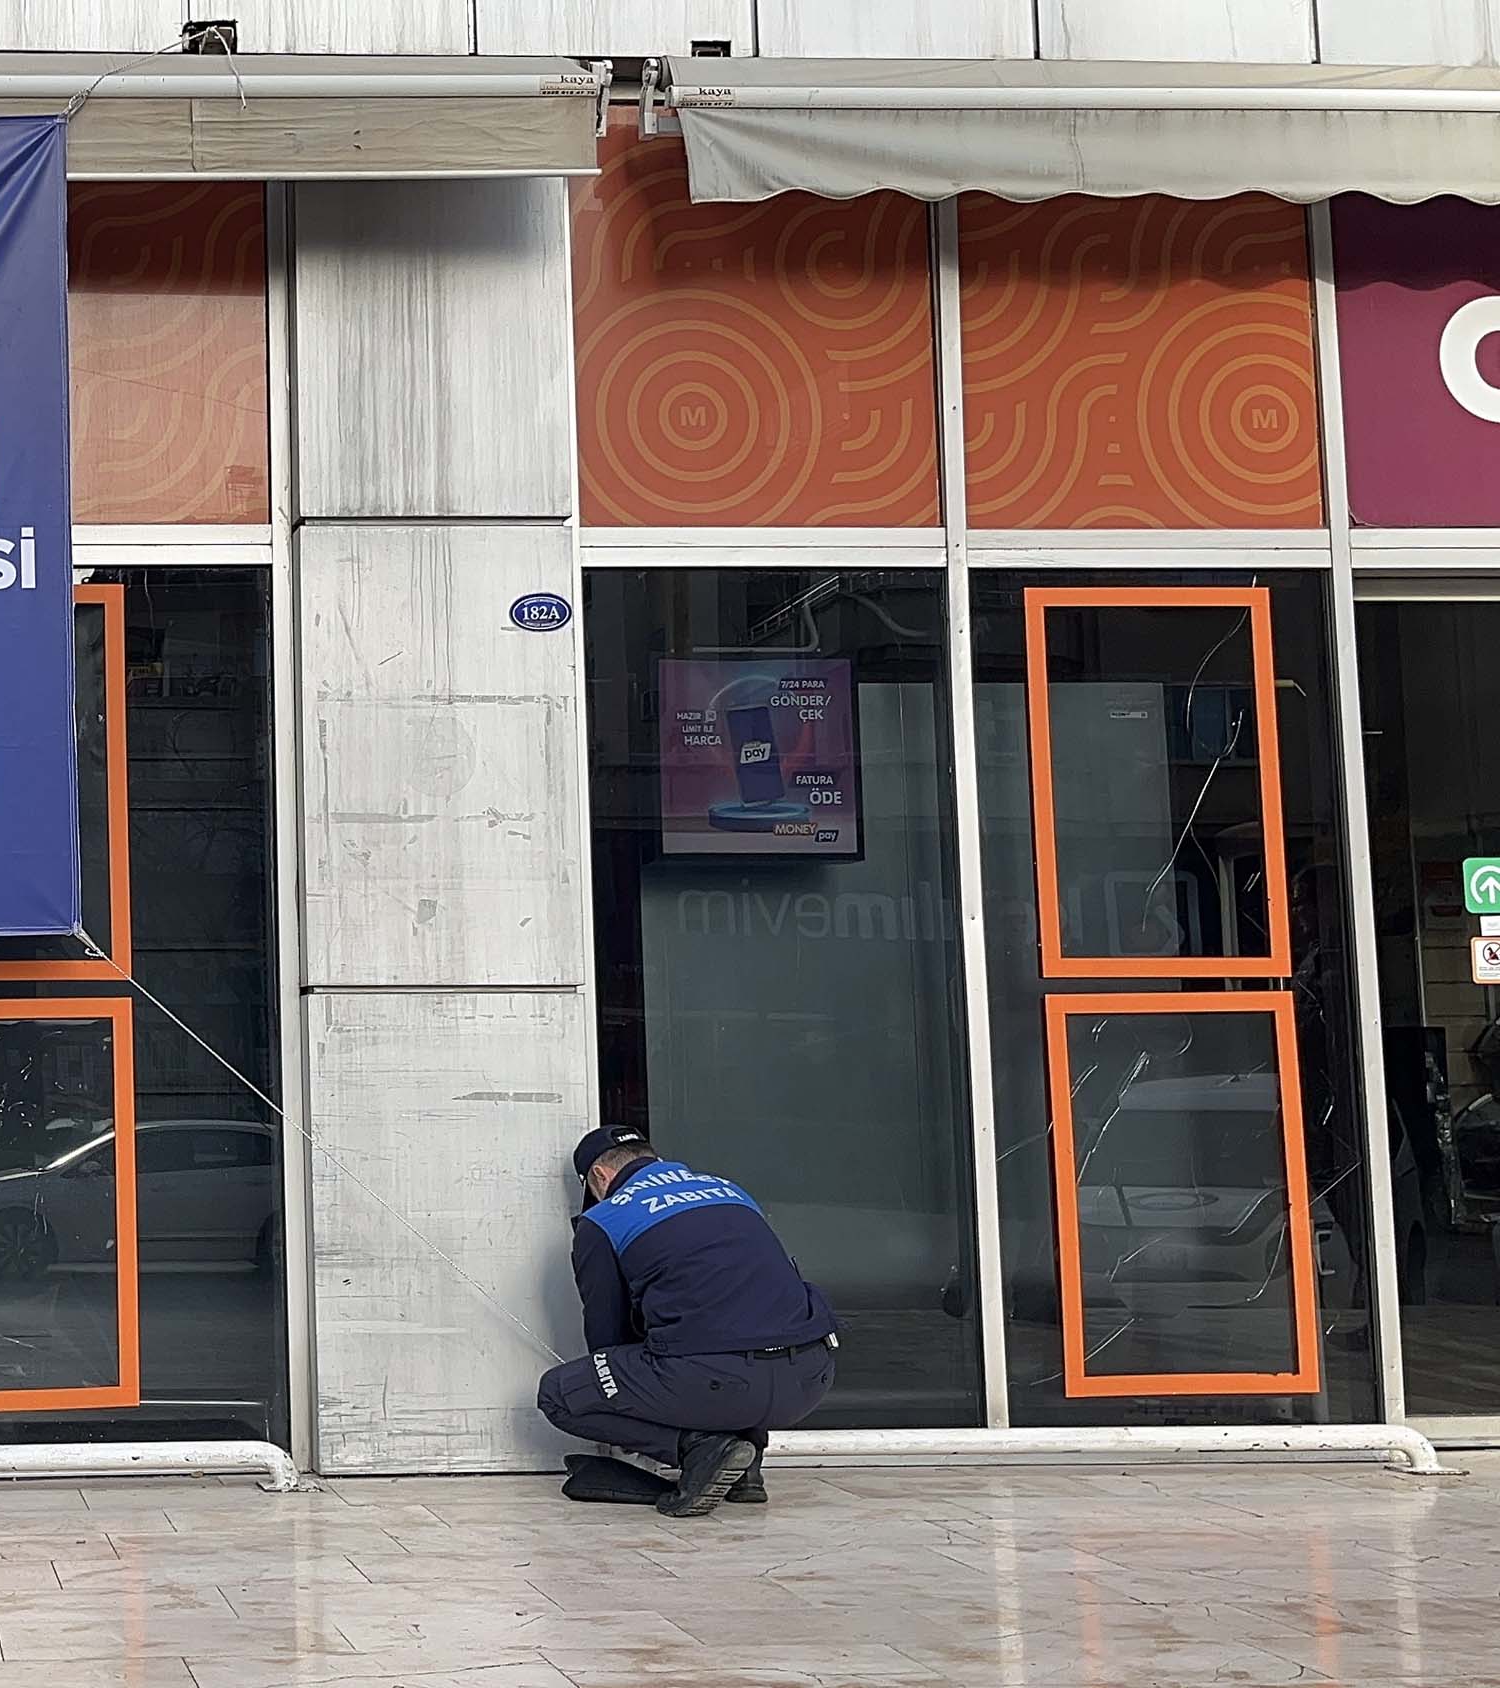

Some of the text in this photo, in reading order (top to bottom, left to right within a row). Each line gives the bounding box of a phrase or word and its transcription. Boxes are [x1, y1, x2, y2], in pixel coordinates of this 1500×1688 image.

[560, 75, 594, 85] kaya
[699, 87, 731, 97] kaya
[522, 606, 560, 620] 182A
[801, 680, 825, 689] PARA
[799, 709, 824, 722] ÇEK
[684, 735, 722, 745] HARCA
[744, 747, 766, 761] pay
[796, 775, 833, 785] FATURA
[809, 788, 842, 805] ÖDE
[774, 823, 836, 842] MONEY pay
[640, 1187, 744, 1214] ZABITA
[593, 1352, 619, 1399] ZABITA
